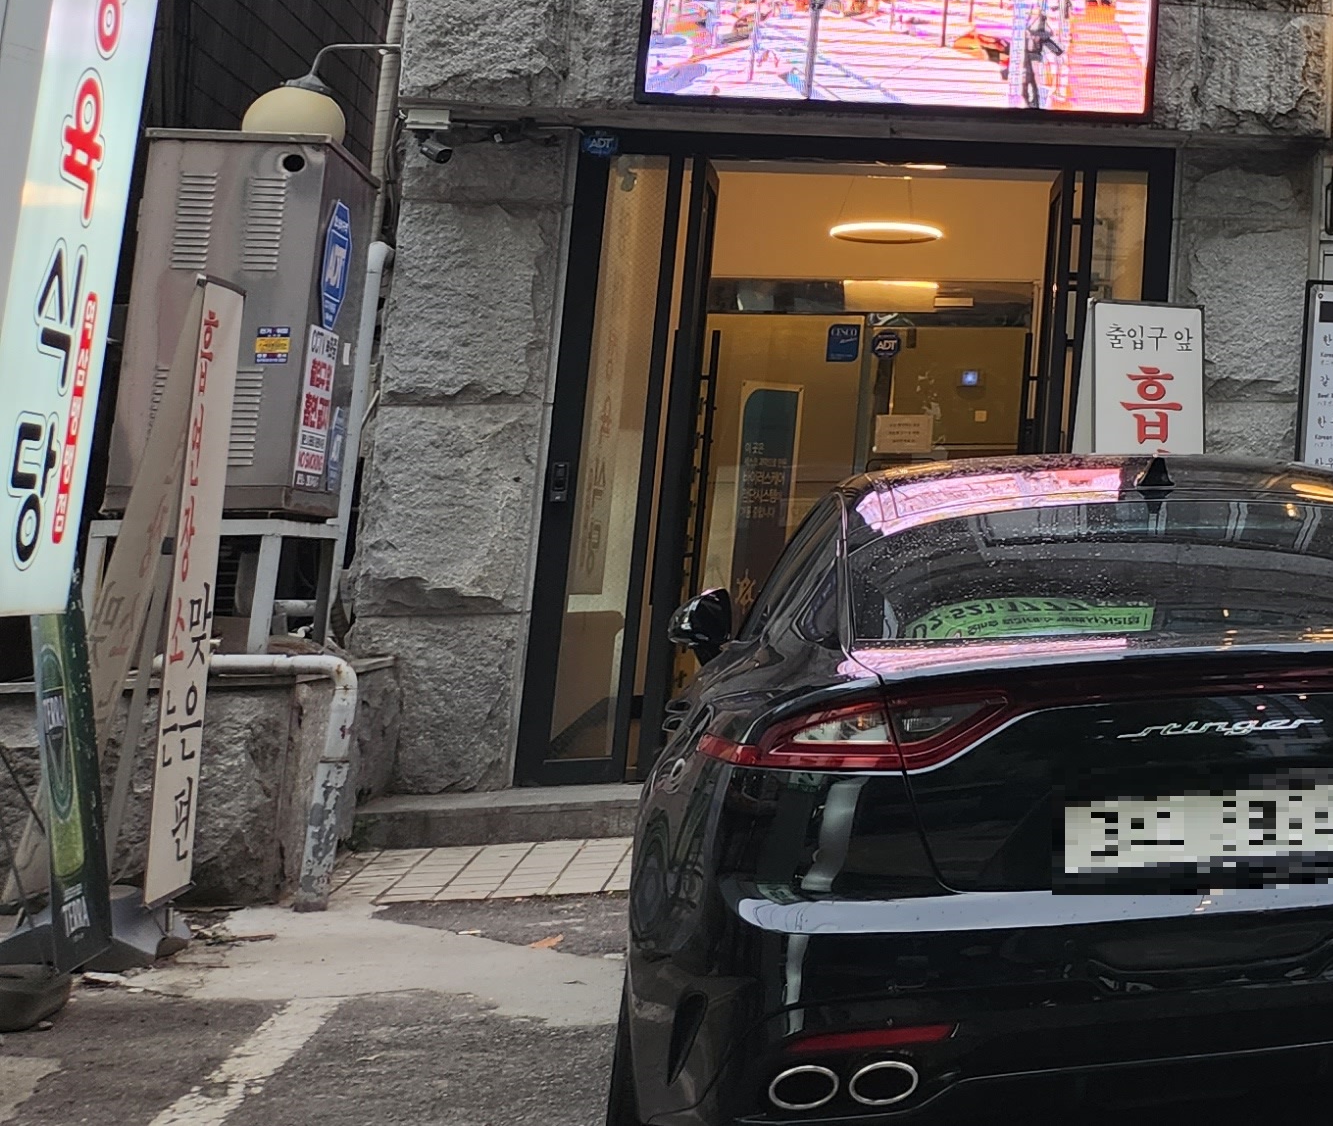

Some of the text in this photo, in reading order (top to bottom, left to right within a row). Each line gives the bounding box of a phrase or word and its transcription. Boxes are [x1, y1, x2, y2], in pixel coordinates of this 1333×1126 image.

[875, 339, 898, 351] ADT
[1105, 323, 1194, 353] 출입구 앞
[1119, 365, 1183, 453] 흡
[1116, 717, 1324, 739] stinger
[61, 895, 91, 939] TERRA
